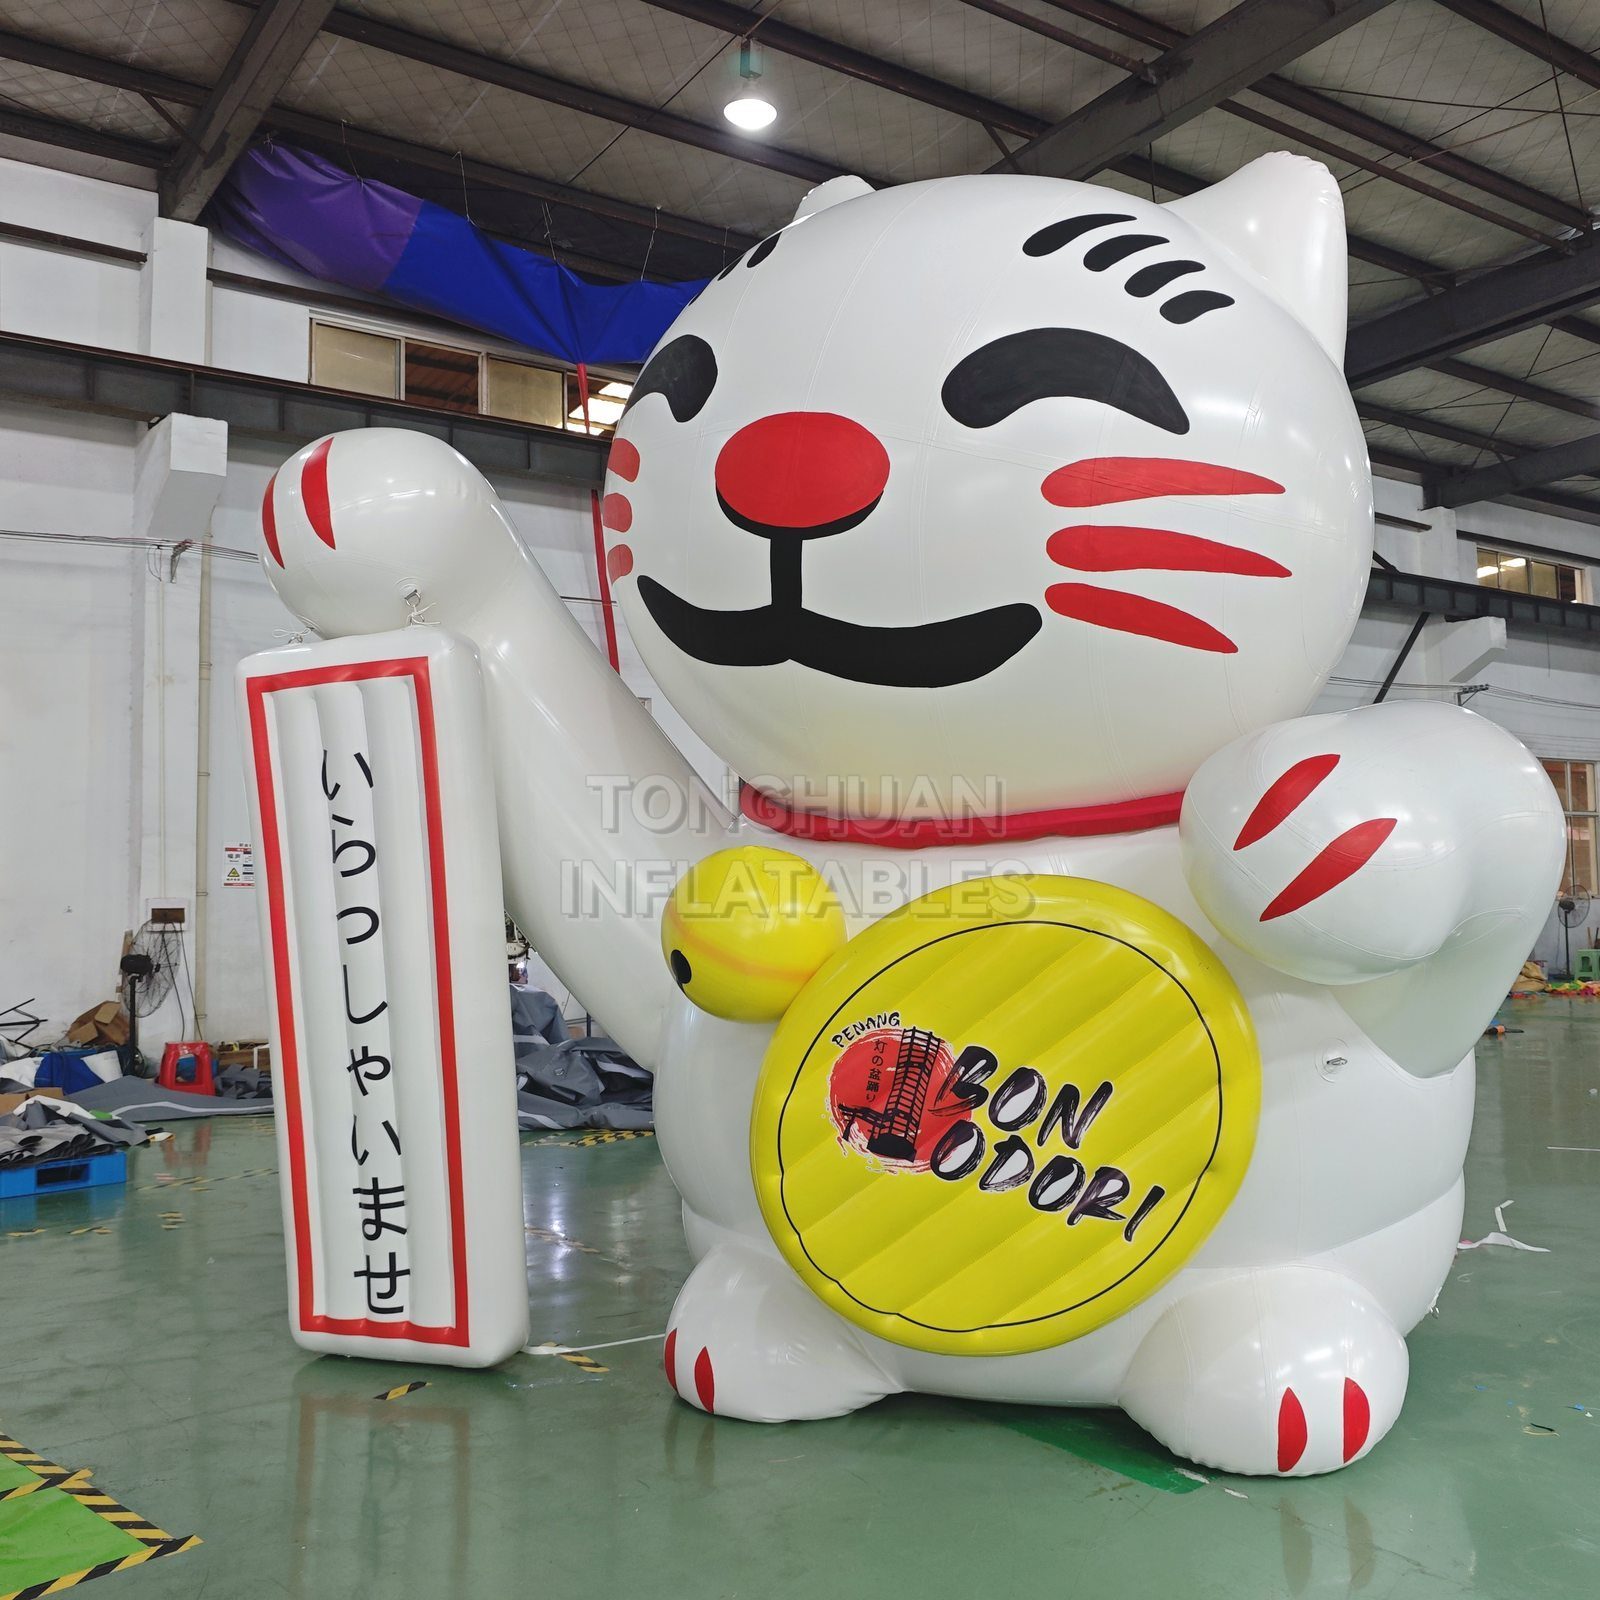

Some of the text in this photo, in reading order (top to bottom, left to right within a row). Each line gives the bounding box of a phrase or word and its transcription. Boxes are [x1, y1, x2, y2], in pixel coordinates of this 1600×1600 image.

[319, 748, 411, 1315] いらっしゃいませ
[832, 1011, 900, 1048] PENANG
[866, 1039, 888, 1102] 灯の盆踊り
[928, 1045, 1113, 1149] BON
[930, 1119, 1165, 1242] ODORI
